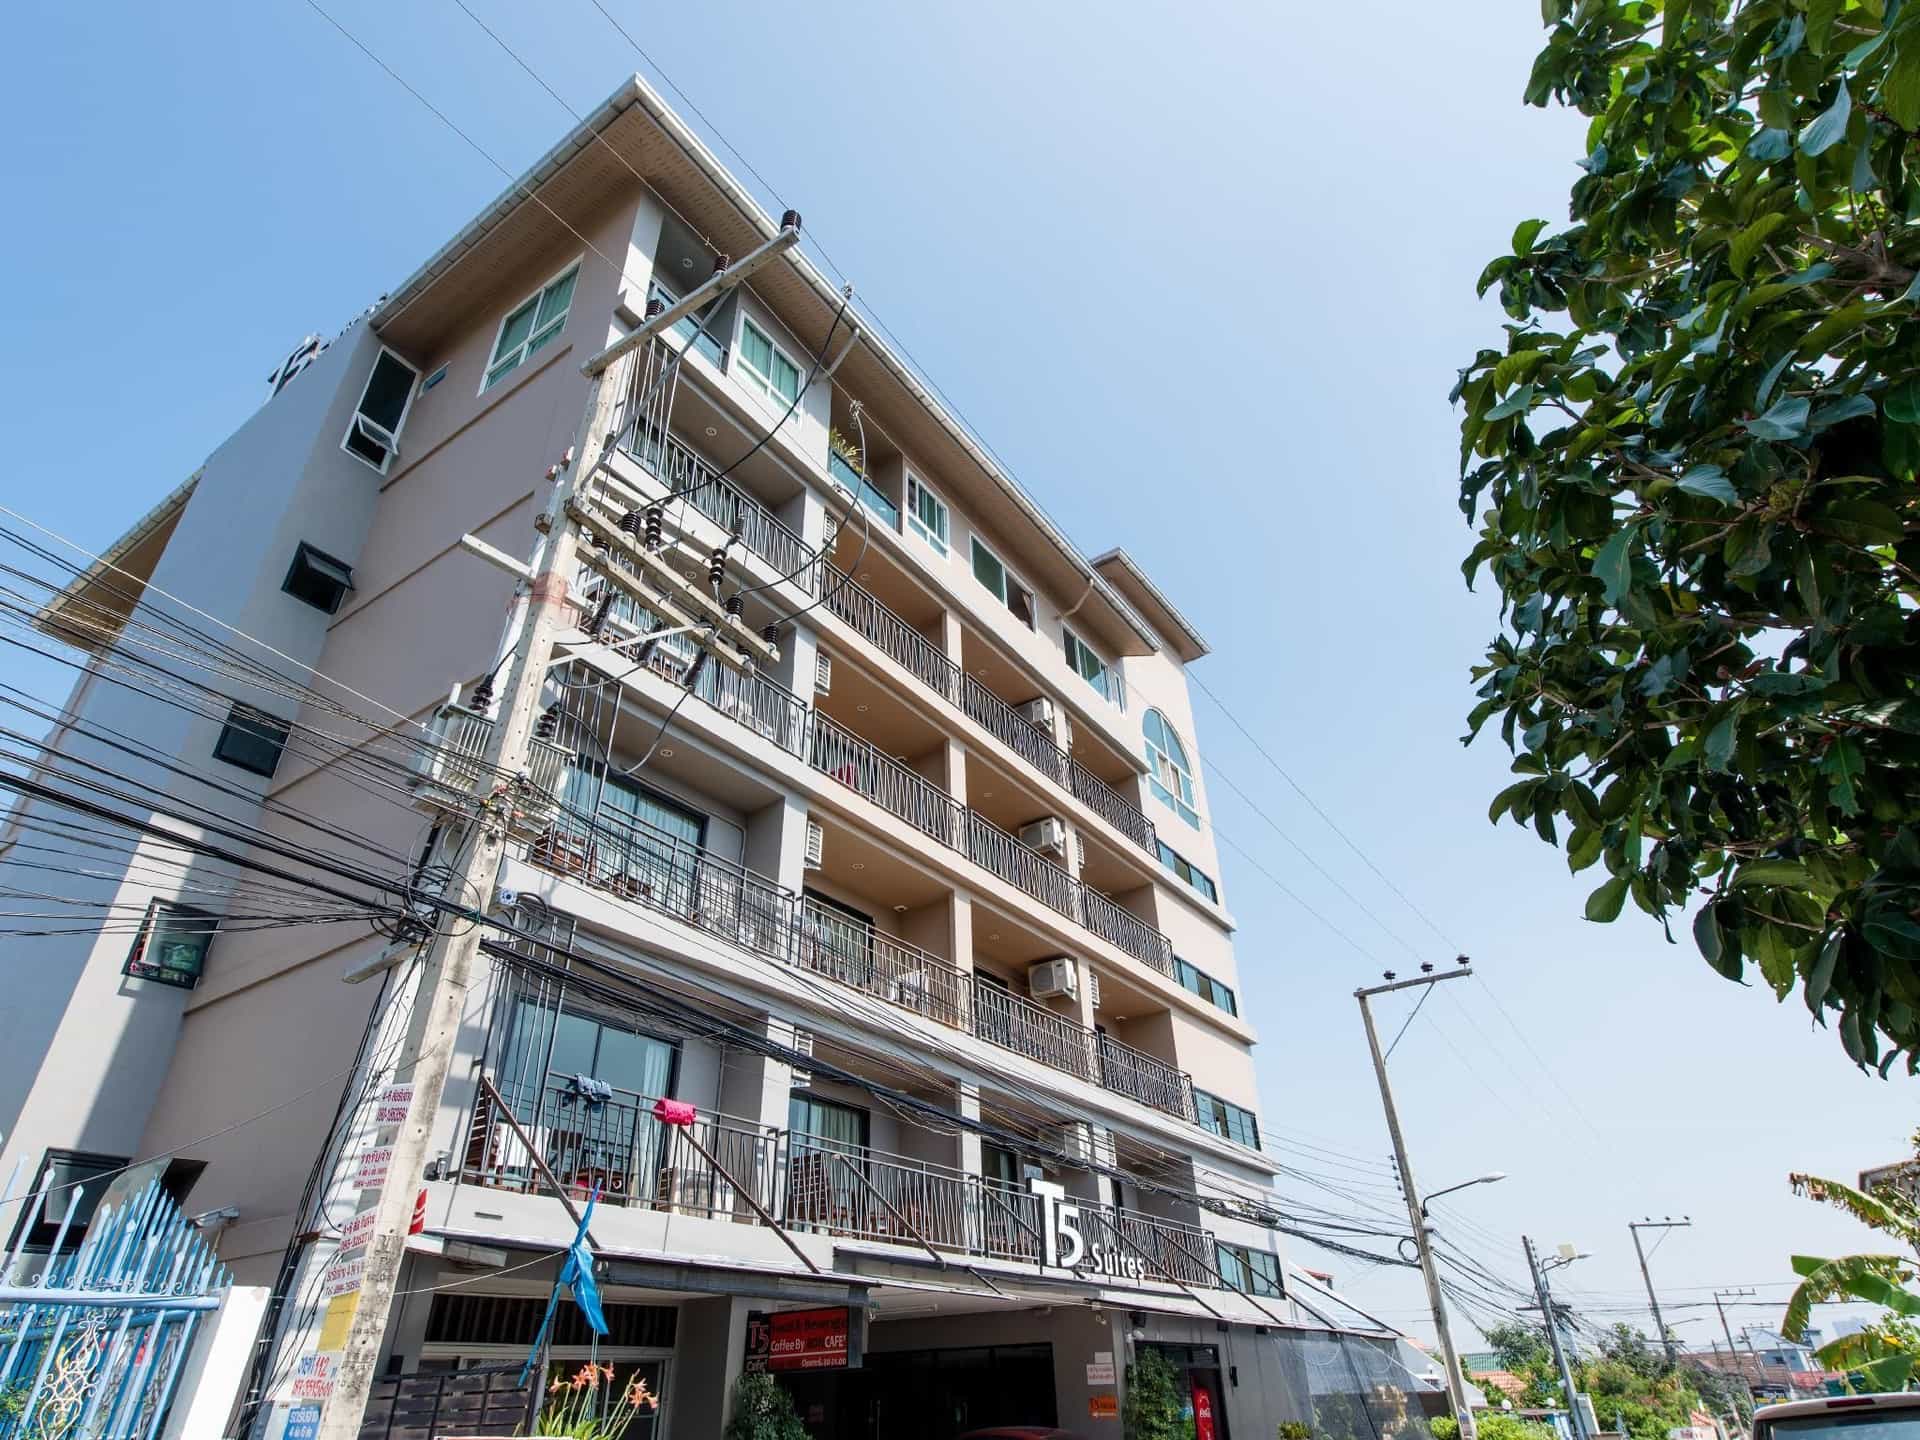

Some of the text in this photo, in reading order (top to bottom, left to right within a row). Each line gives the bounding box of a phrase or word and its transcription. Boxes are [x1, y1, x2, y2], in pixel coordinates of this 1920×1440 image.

[1031, 1177, 1145, 1281] T5 Suites
[749, 1321, 769, 1353] T5
[770, 1338, 794, 1353] Coffee
[795, 1337, 805, 1353] By
